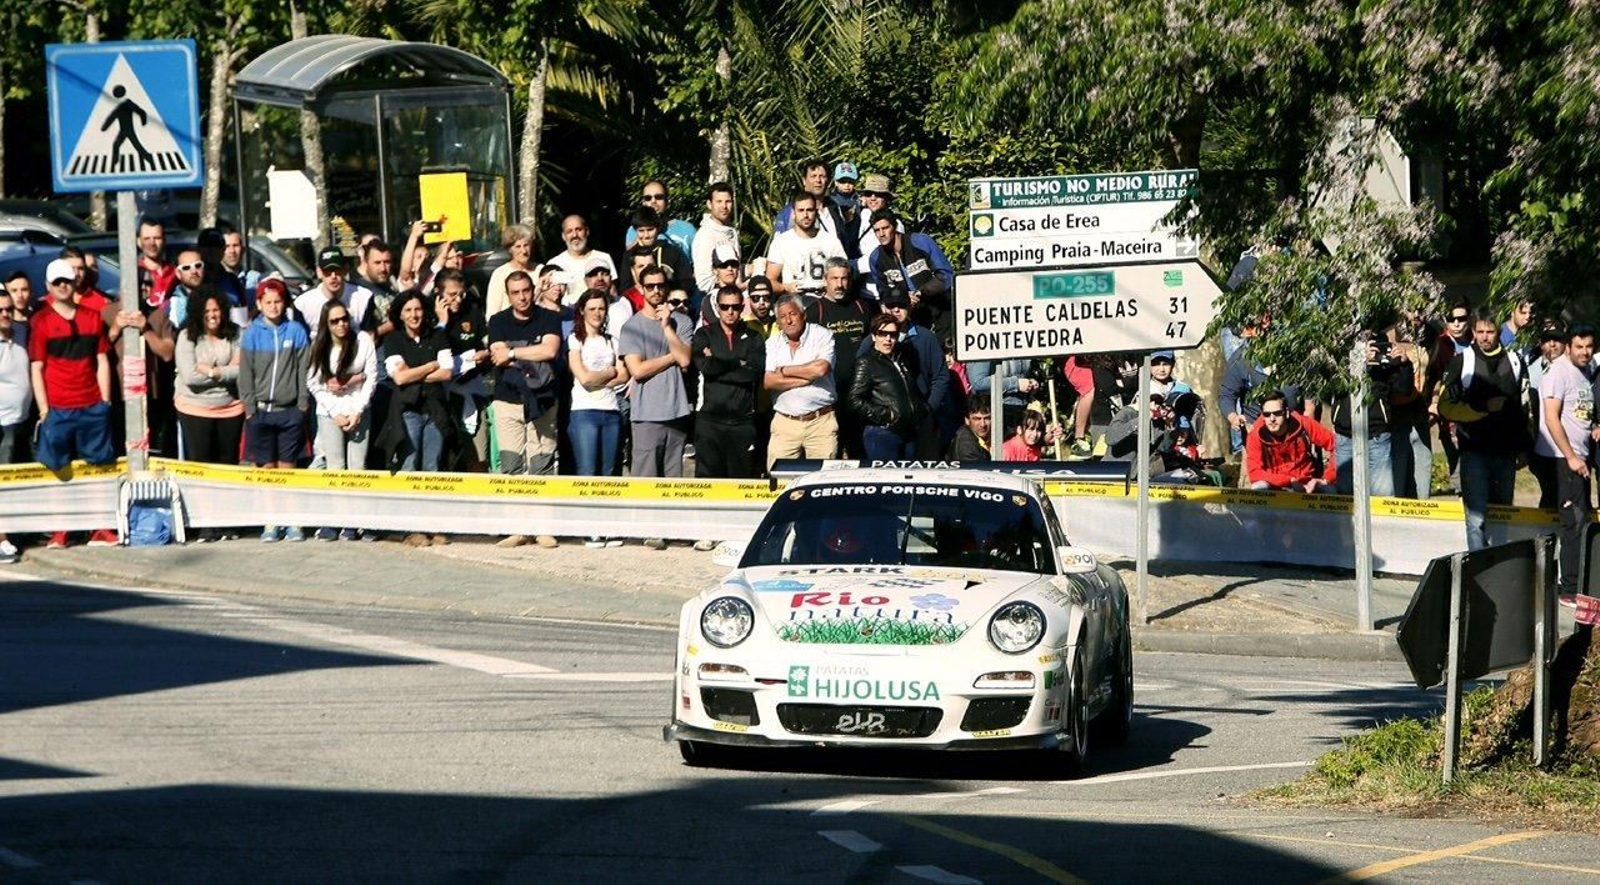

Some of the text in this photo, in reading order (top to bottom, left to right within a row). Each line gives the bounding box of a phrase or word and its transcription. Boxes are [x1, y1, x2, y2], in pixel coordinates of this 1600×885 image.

[992, 173, 1195, 197] TURISMO NO MEDIO RURA
[1138, 191, 1152, 200] 986
[1154, 190, 1163, 199] 65
[1166, 190, 1175, 198] 23
[999, 213, 1100, 232] Casa de Erea
[975, 244, 1044, 266] Camping
[1038, 275, 1108, 294] PO-255
[964, 297, 1188, 326] PUENTE CALDELAS 31
[965, 321, 1187, 351] PONTEVEDRA 47
[871, 460, 960, 470] PATATAS
[811, 485, 1004, 503] CENTRO PORSCHE VIGO
[780, 567, 904, 577] STARK
[790, 592, 890, 609] Rio
[789, 606, 954, 624] natura
[815, 665, 869, 676] PATATAS
[815, 679, 941, 701] HIJOLUSA
